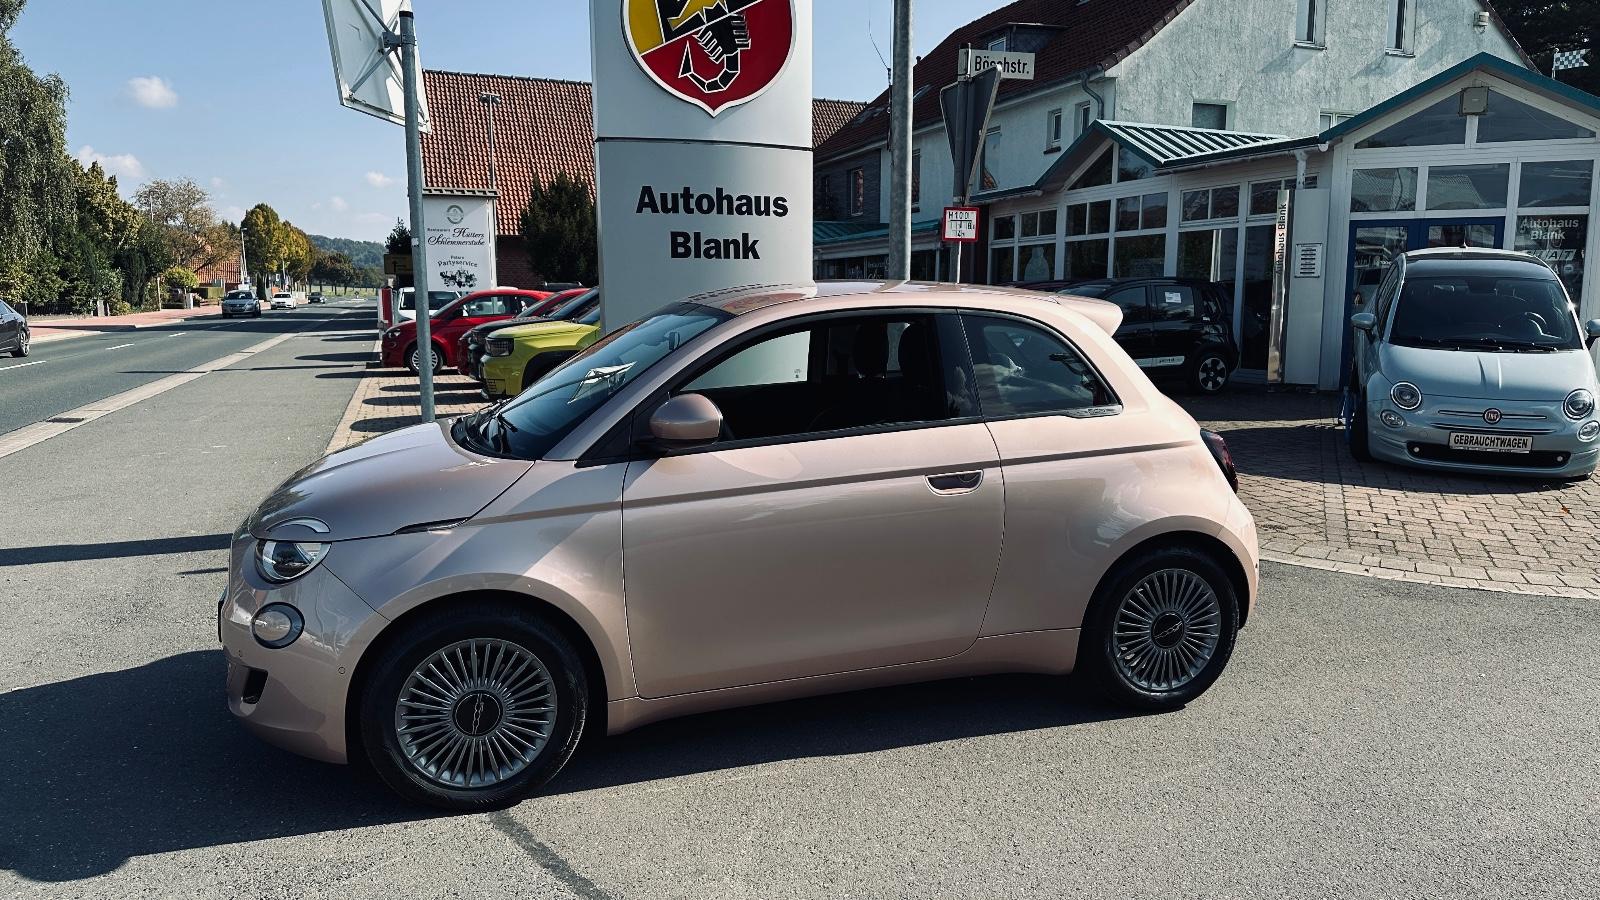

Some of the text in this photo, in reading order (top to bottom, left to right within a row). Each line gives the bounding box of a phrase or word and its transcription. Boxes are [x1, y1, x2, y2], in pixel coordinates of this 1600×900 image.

[636, 185, 789, 217] Autohaus
[1277, 203, 1287, 230] Blank
[1520, 218, 1579, 229] Autohaus
[1531, 229, 1566, 240] Blank
[670, 231, 760, 259] Blank
[437, 259, 478, 268] Partyservice
[1453, 434, 1529, 449] GEBRAUCHTWAGEN
